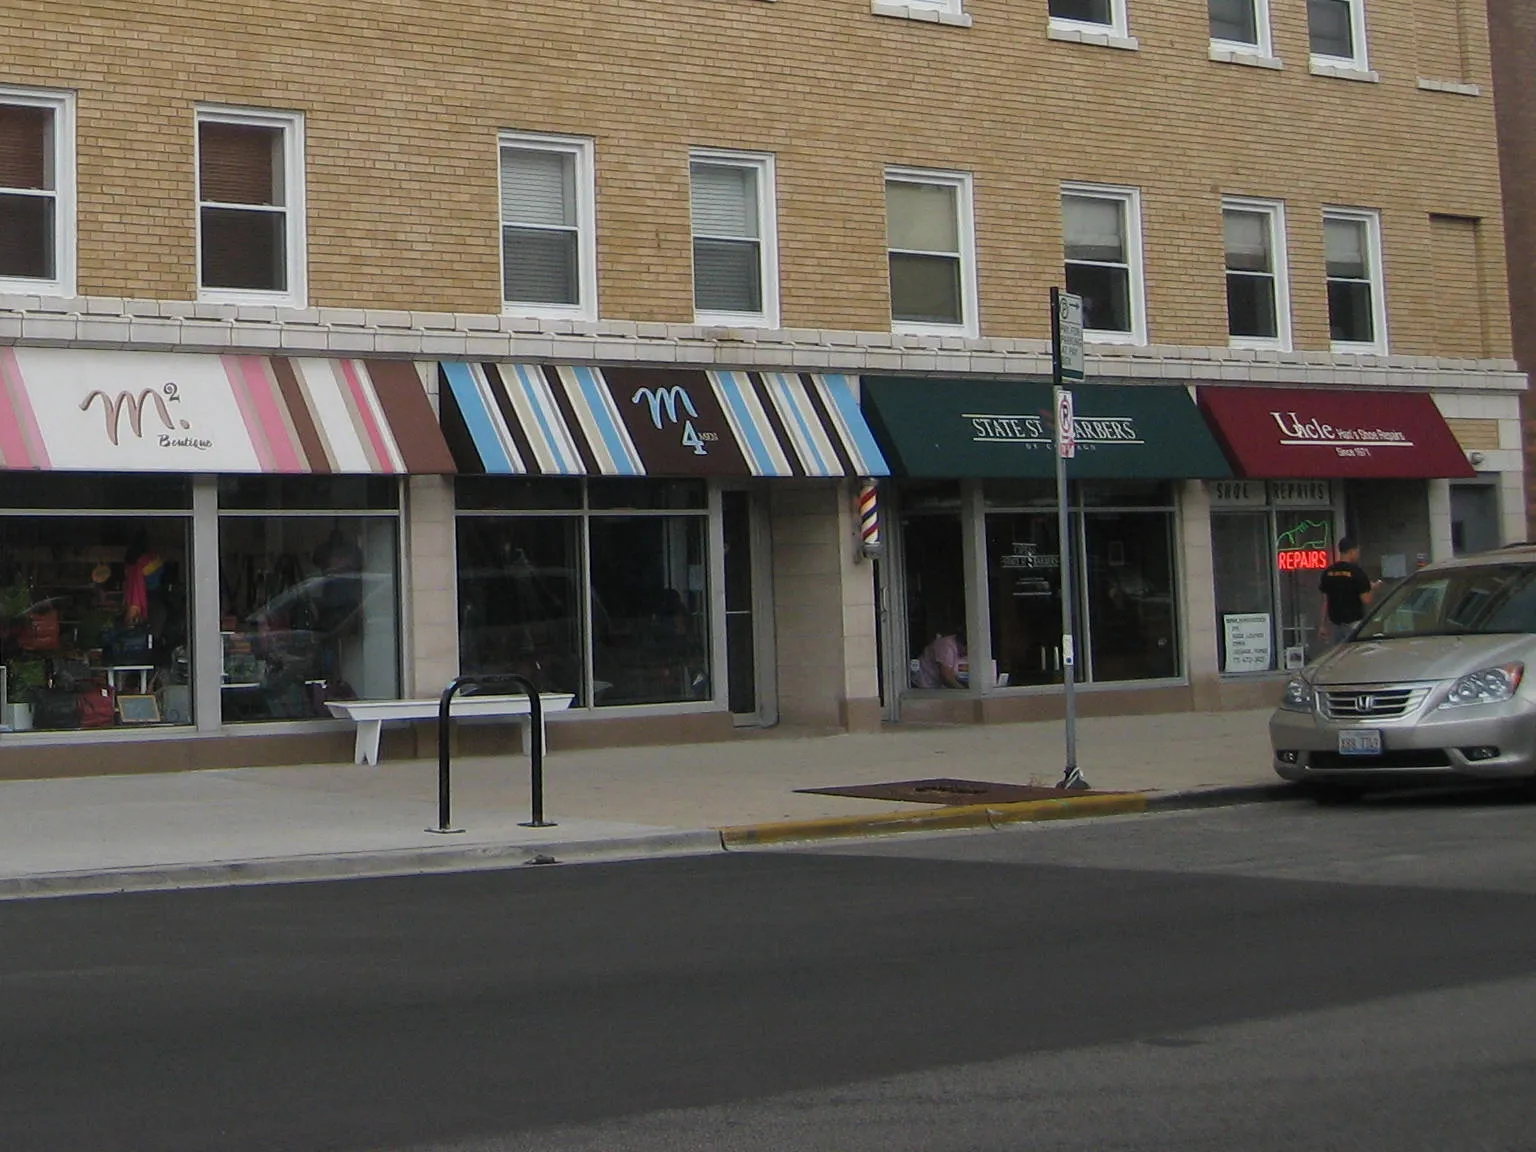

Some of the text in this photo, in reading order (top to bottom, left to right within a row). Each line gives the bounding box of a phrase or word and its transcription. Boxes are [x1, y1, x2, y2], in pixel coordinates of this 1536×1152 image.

[972, 419, 1026, 438] STATE
[1073, 421, 1137, 439] ARBERS
[1269, 411, 1335, 439] Uncle
[1271, 482, 1325, 501] REPAIRS
[1278, 550, 1327, 570] REPAIRS
